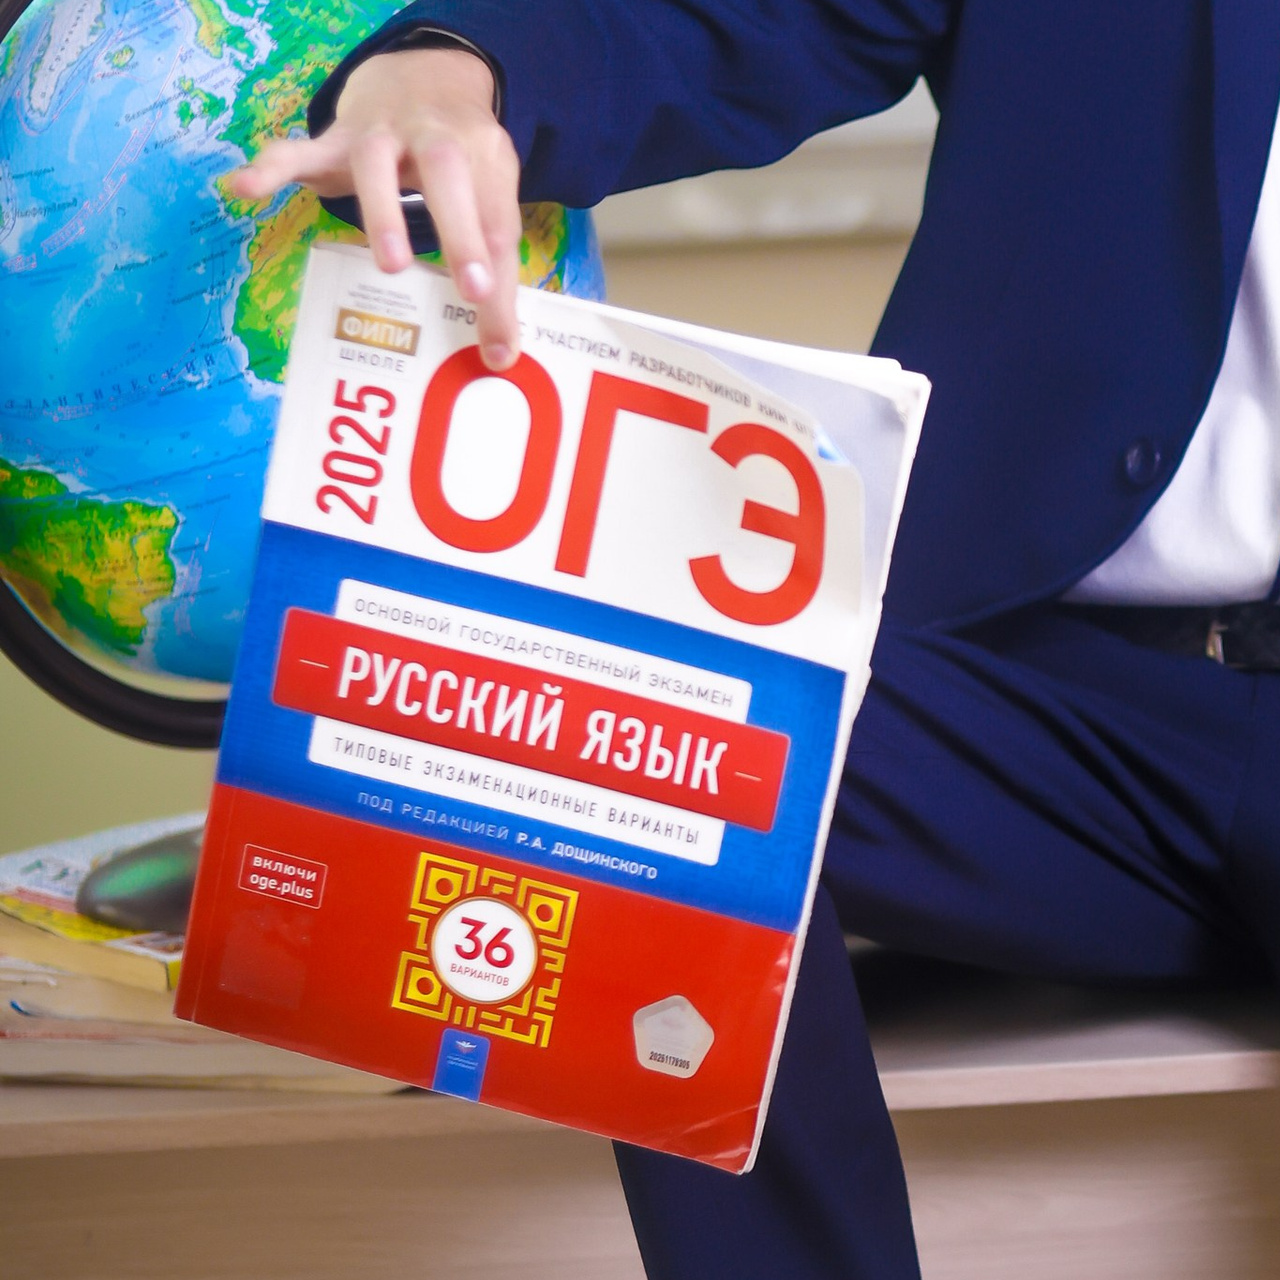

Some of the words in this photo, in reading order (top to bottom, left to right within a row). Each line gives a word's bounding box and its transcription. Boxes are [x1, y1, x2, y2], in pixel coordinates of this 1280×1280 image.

[339, 347, 405, 372] ШКОЛЕ
[341, 315, 414, 351] ФИПИ
[535, 325, 621, 361] УЧАСТИЕМ
[629, 351, 751, 408] РАЗРАБОТЧИКОВ
[316, 378, 397, 525] 2025
[410, 344, 827, 627] ОГЭ
[354, 597, 451, 635] ОСНОВНОЙ
[459, 625, 641, 683] ГОСУДАРСТВЕННЫЙ
[648, 673, 733, 708] ЭКЗАМЕН
[338, 645, 566, 752] РУССКИЙ
[578, 708, 729, 796] ЯЗЫК
[334, 736, 413, 772] ТИПОВЫЕ
[423, 760, 597, 818] ЭКЗАМЕНАЦИОННЫЕ
[607, 807, 700, 846] ВАРИАНТЫ
[252, 856, 317, 882] включи
[357, 792, 393, 815] ПОД
[401, 802, 510, 841] РЕДАКЦИЕЙ
[516, 832, 547, 852] Р.А.
[551, 841, 659, 880] ДОЩИНСКОГО
[250, 873, 314, 899] oge.plus
[450, 963, 510, 986] ВАРИАНТОВ
[454, 916, 515, 969] 36
